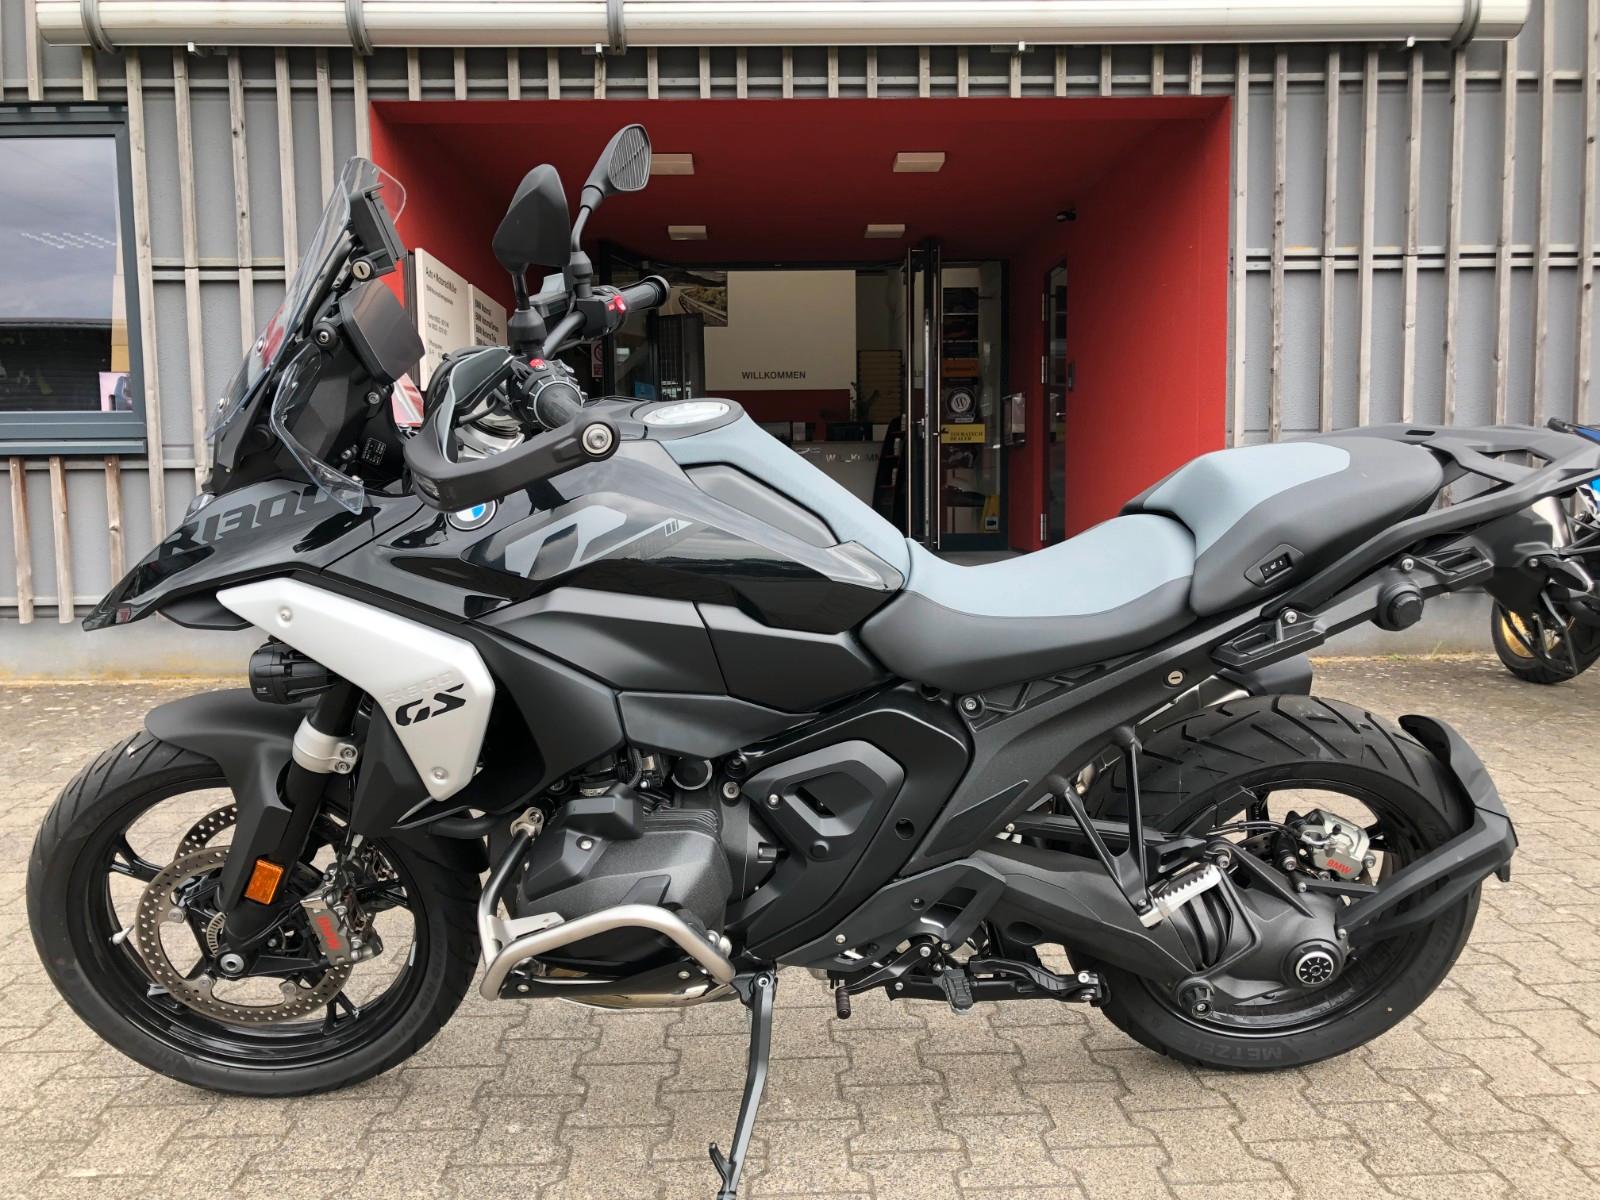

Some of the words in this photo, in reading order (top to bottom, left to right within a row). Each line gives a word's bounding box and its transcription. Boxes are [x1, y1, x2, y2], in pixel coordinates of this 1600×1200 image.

[742, 371, 806, 380] WILLKOMMEN
[396, 683, 466, 726] GS
[1327, 858, 1352, 874] BMW
